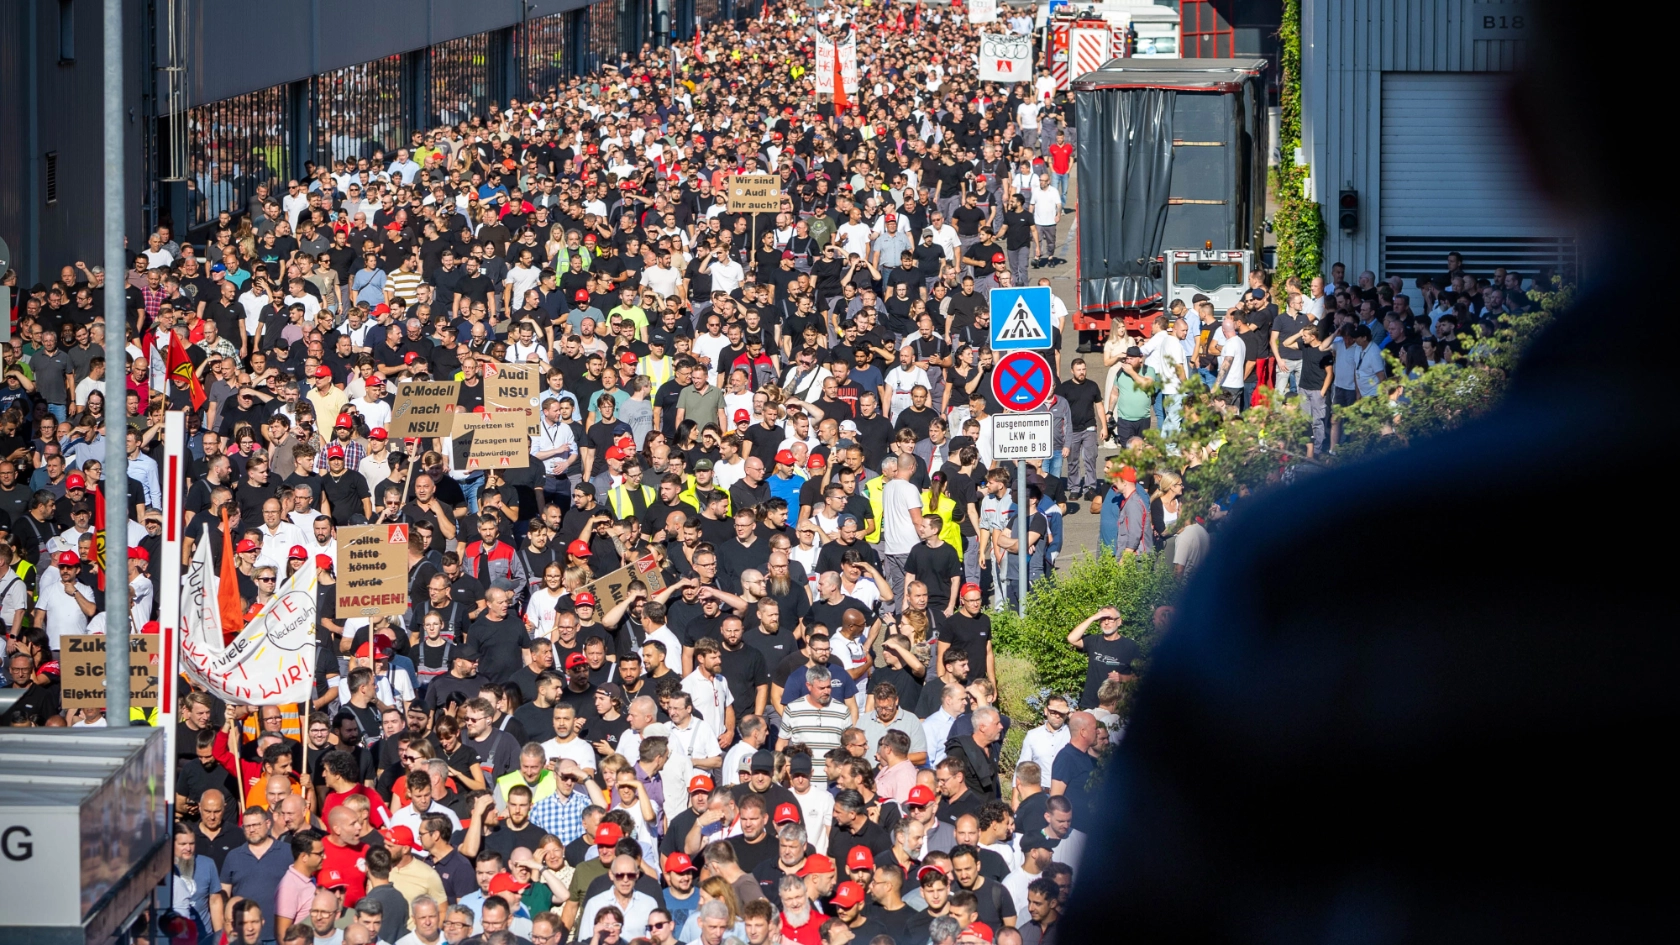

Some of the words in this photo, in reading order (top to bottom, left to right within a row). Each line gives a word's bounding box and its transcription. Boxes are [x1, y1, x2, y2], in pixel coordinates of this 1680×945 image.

[1483, 15, 1525, 29] B18
[745, 189, 767, 197] Audi
[498, 369, 529, 380] Audi
[402, 386, 454, 396] Q-Modell
[498, 387, 529, 397] NSU
[410, 404, 440, 414] nach
[408, 422, 439, 432] NSU!
[996, 420, 1049, 430] ausgenommen
[474, 437, 508, 445] Zusagen
[1009, 431, 1025, 441] LKW
[1029, 431, 1036, 440] in
[999, 444, 1028, 453] Vorzone
[1031, 442, 1036, 452] B
[1038, 442, 1047, 452] 18
[349, 549, 379, 559] hätte
[348, 561, 387, 572] könnte
[348, 577, 383, 588] würde
[339, 593, 405, 608] MACHEN!
